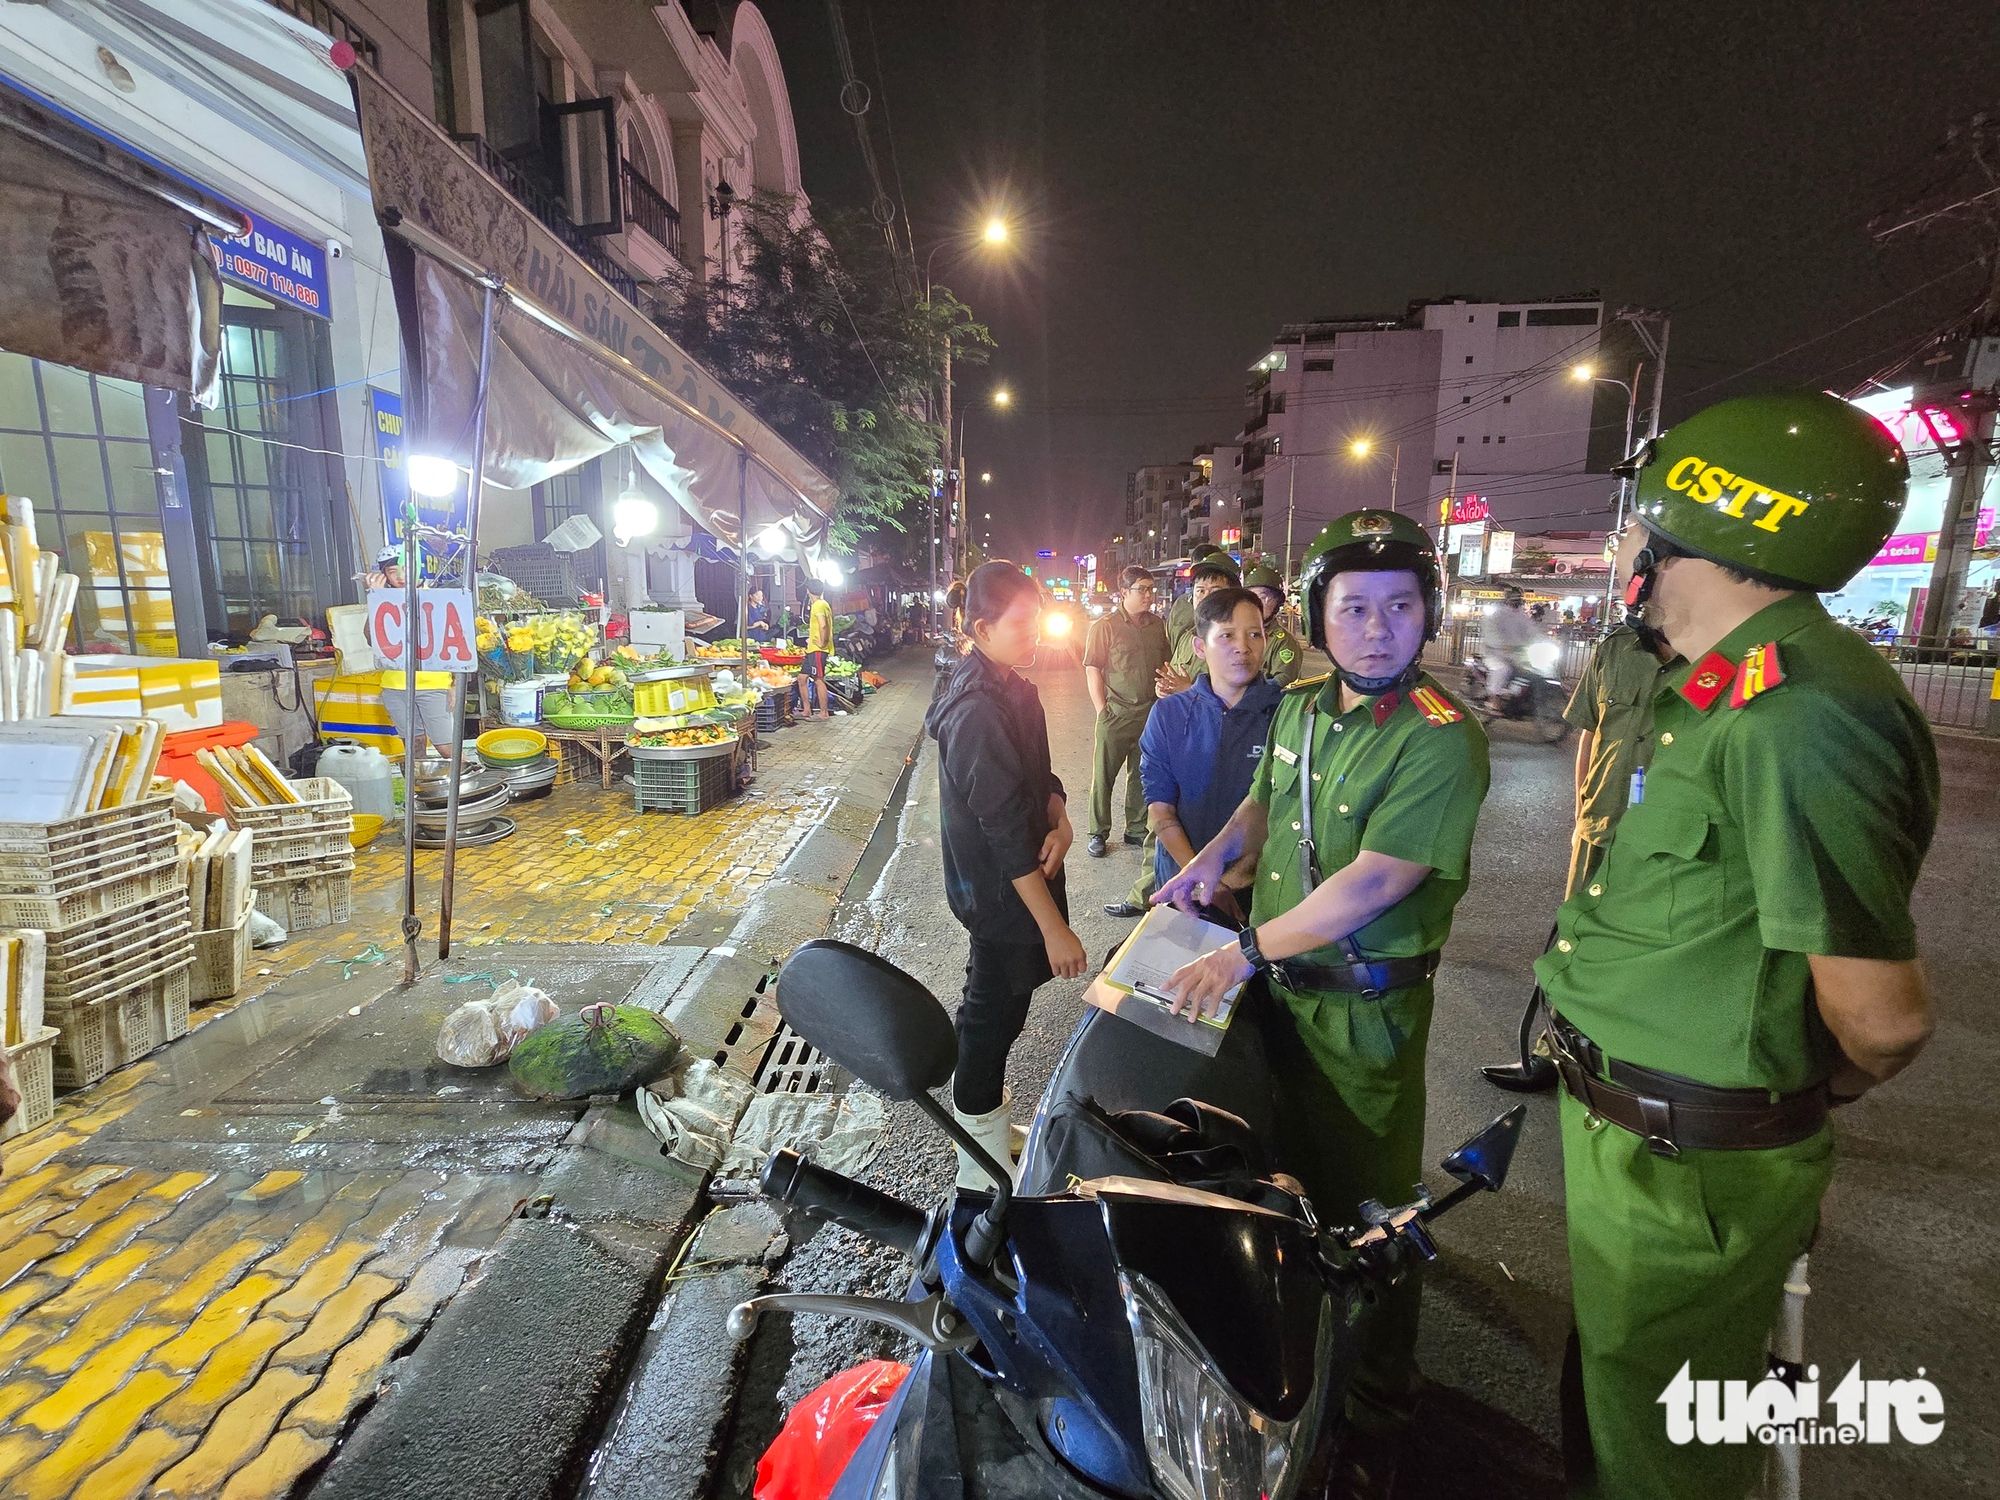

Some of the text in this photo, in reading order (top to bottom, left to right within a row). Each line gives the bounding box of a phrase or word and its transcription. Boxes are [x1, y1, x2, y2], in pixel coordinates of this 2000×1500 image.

[234, 255, 268, 286] 0977
[270, 271, 294, 299] 114
[296, 283, 319, 308] 880
[254, 231, 287, 266] BAO
[291, 246, 312, 279] ĂN
[528, 246, 576, 320] HẢI
[584, 292, 628, 358] SẢN
[1666, 456, 1810, 533] CSTT
[374, 601, 472, 662] CUA
